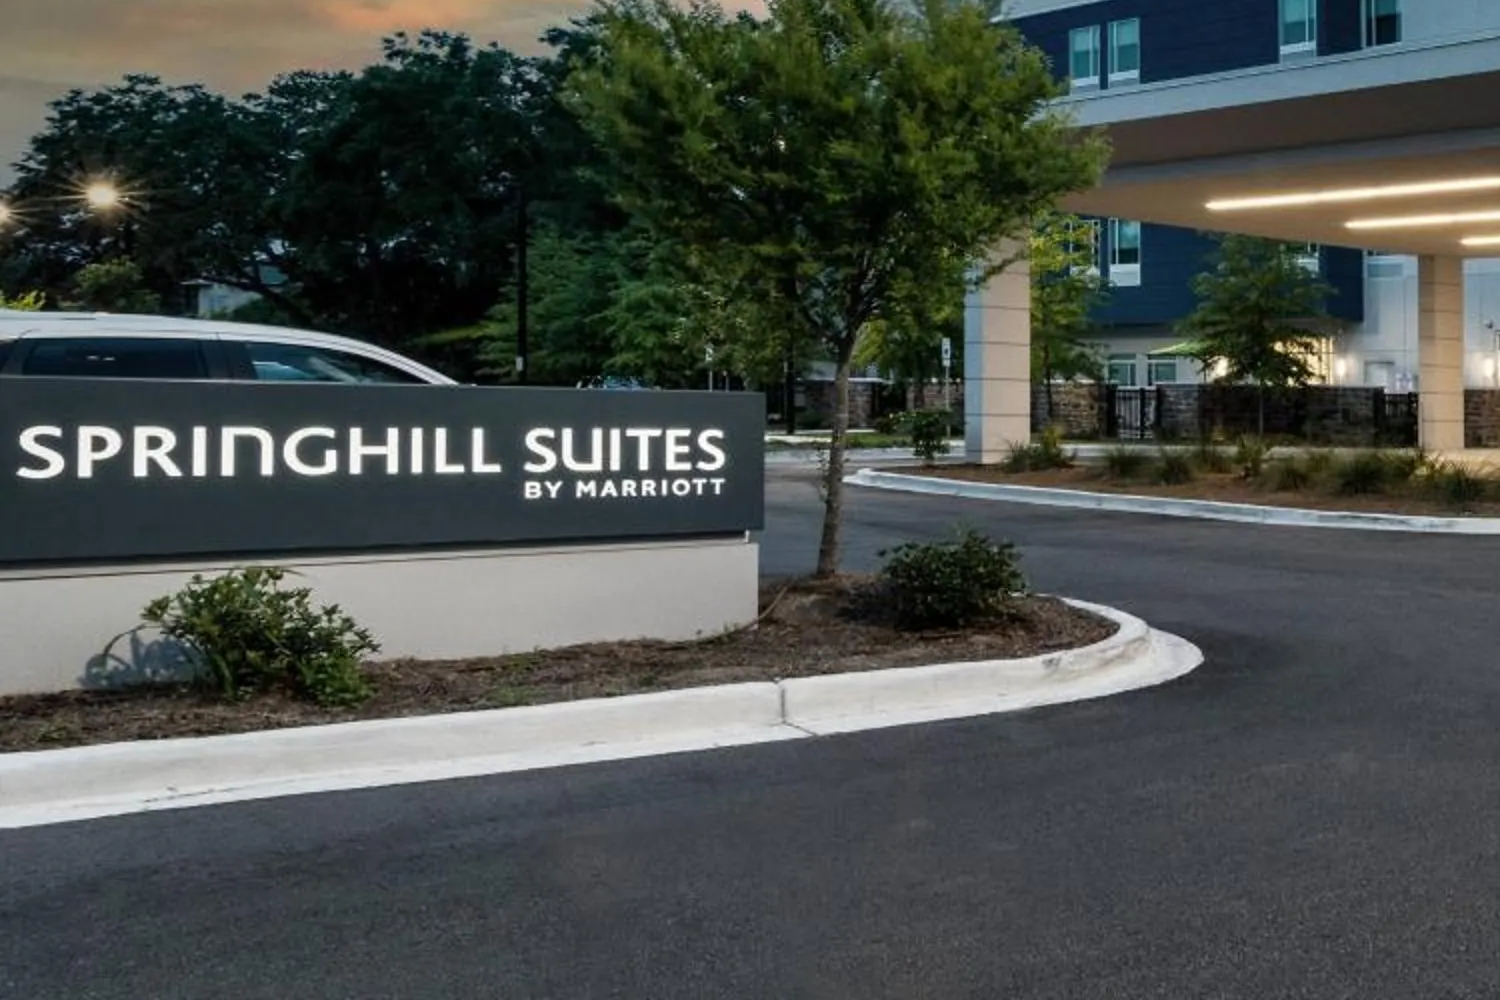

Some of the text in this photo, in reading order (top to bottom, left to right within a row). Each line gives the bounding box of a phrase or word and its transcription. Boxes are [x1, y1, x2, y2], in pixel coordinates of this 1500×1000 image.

[15, 424, 727, 480] SPRINGHILL SUITES
[523, 477, 727, 500] BY MARRIOTT
